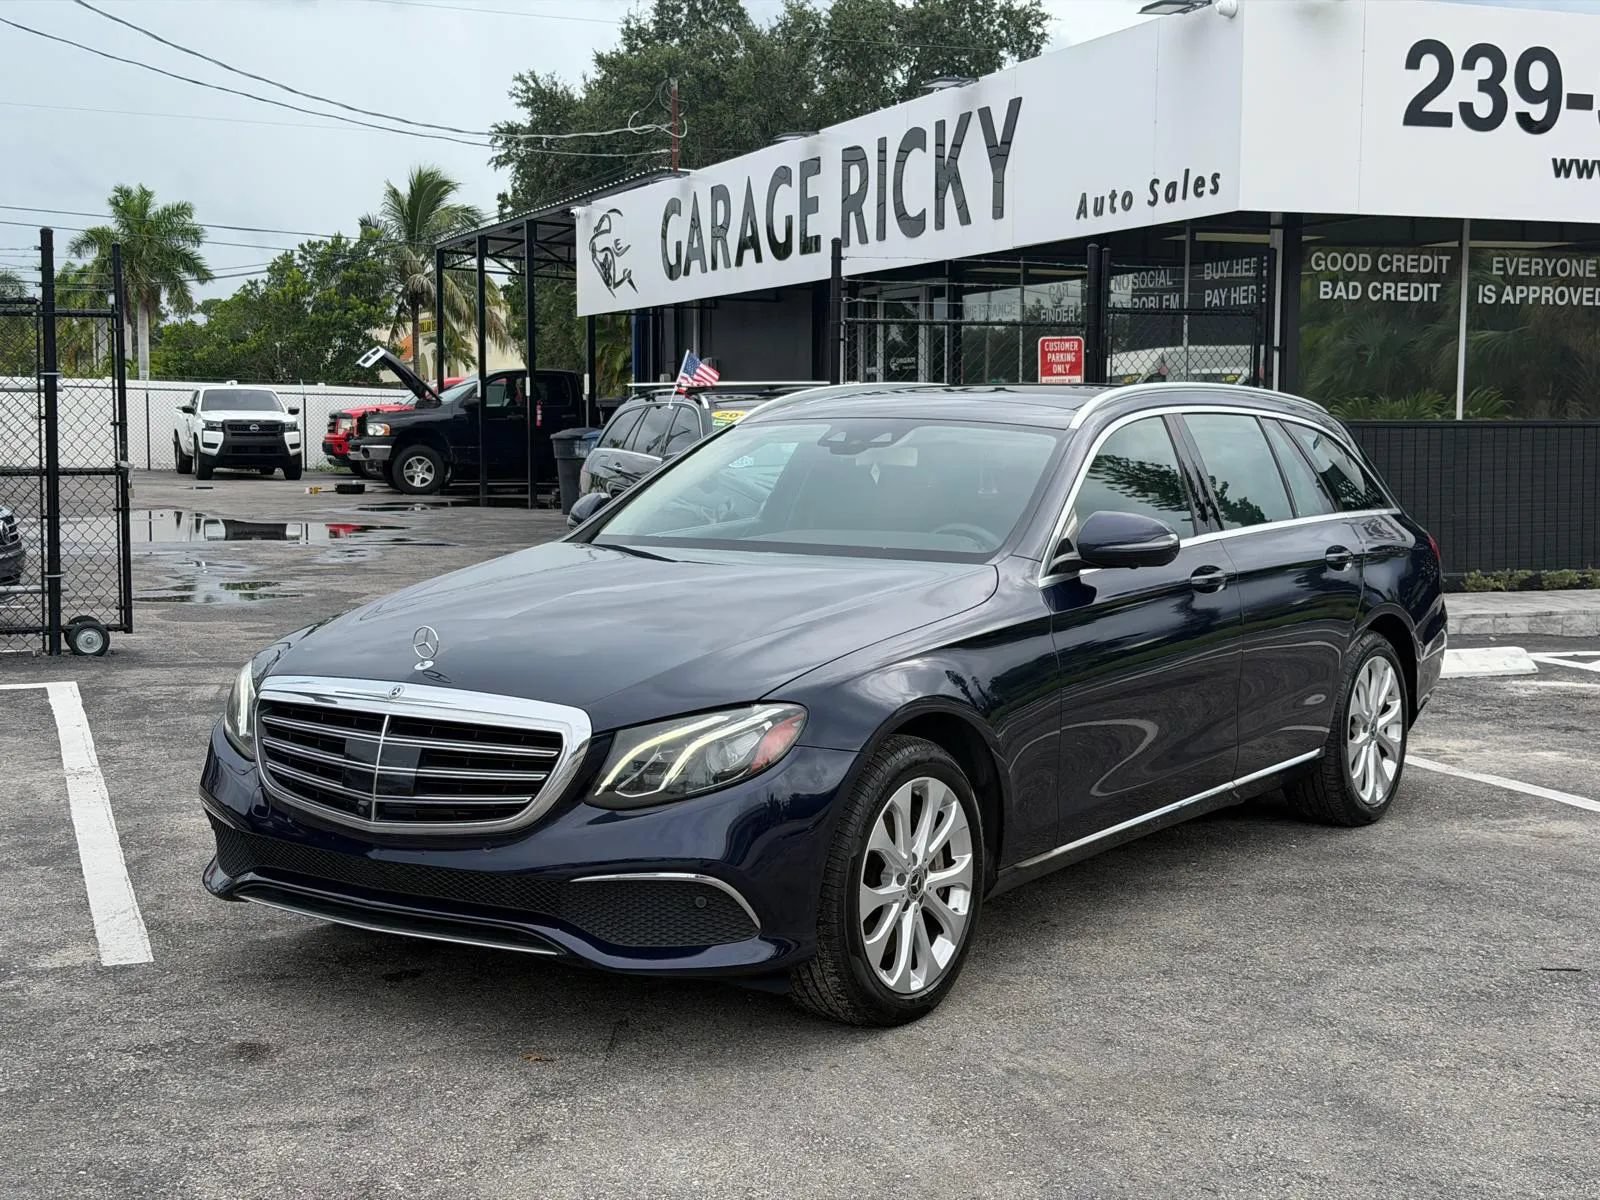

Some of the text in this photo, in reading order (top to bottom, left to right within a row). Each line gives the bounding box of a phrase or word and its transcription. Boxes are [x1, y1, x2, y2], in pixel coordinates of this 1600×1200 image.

[1403, 38, 1600, 135] 239-
[660, 96, 1023, 282] GARAGE RICKY
[1075, 168, 1221, 220] Auto Sales
[1204, 260, 1230, 280] BUY
[1311, 252, 1451, 273] GOOD CREDIT
[1492, 257, 1597, 277] EVERYONE
[1114, 269, 1173, 291] NO SOCIAL
[1204, 288, 1228, 308] PAY
[1319, 281, 1441, 302] BAD CREDIT
[1477, 284, 1497, 304] IS
[1040, 306, 1075, 322] FINDER
[1044, 341, 1079, 352] CUSTOMER
[1047, 352, 1076, 363] PARKING
[1052, 363, 1070, 374] ONLY
